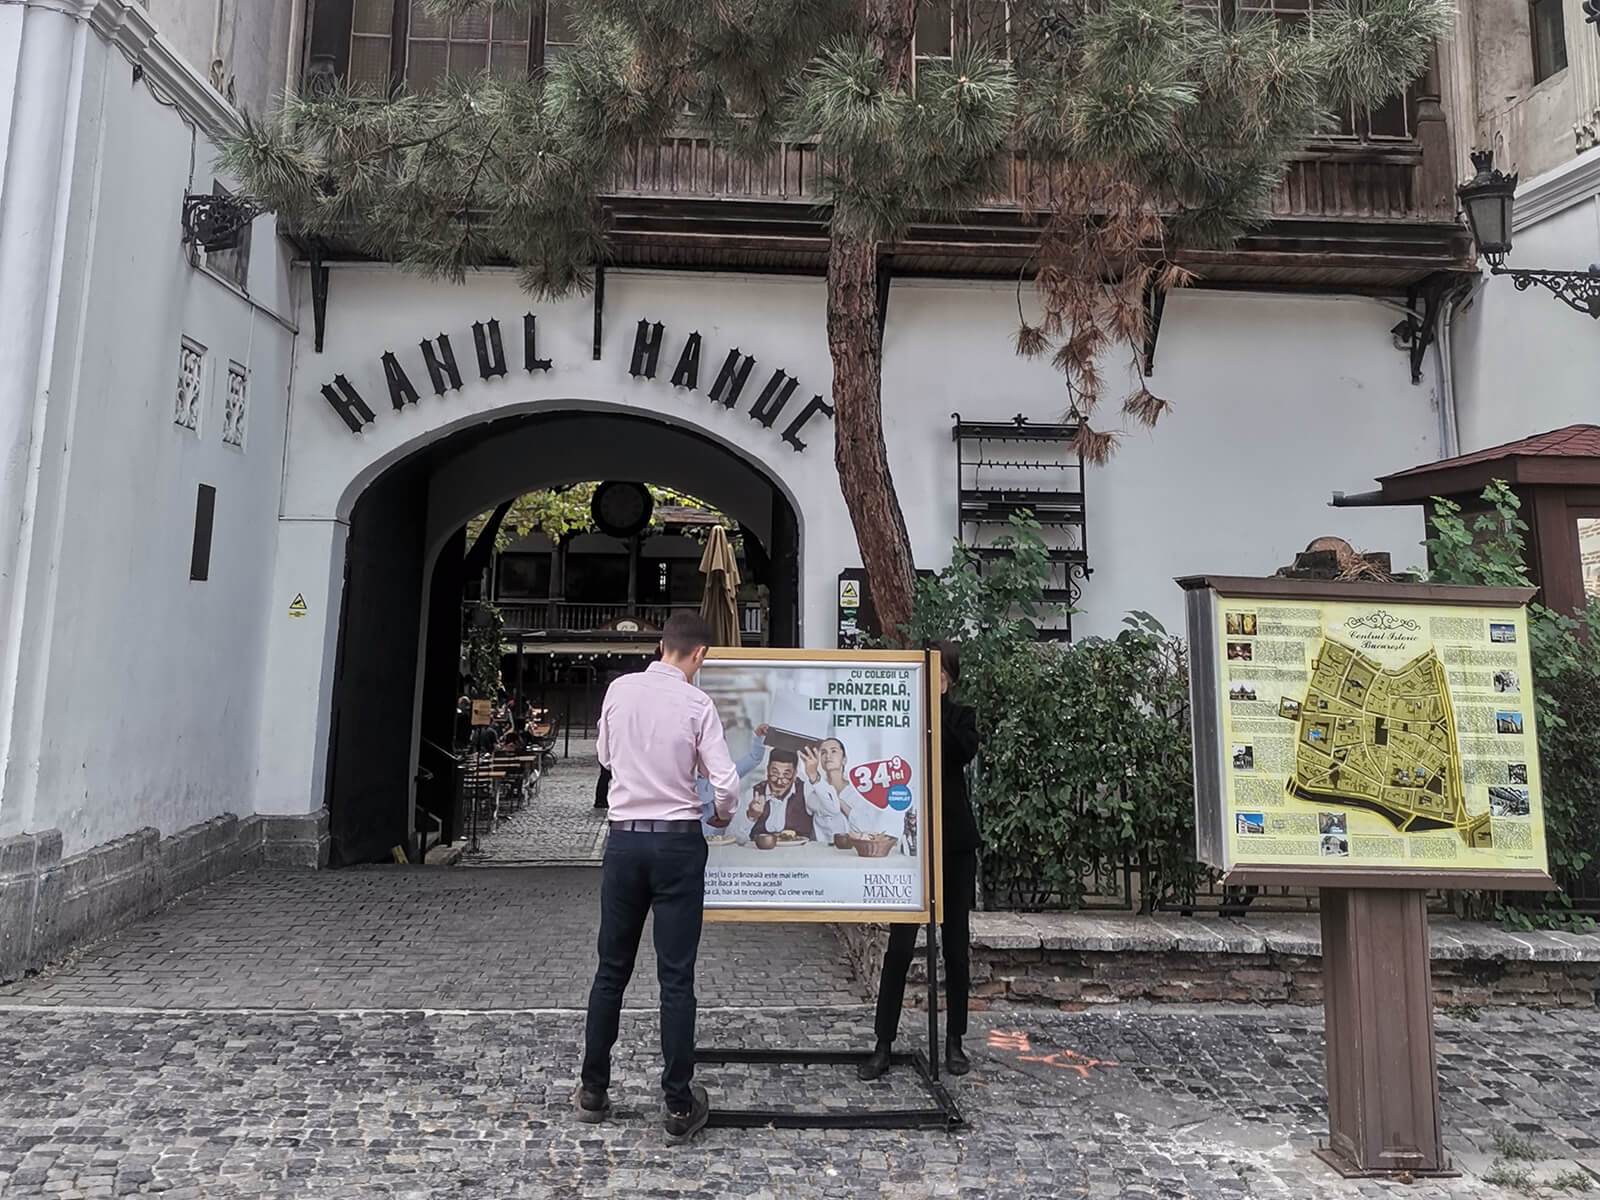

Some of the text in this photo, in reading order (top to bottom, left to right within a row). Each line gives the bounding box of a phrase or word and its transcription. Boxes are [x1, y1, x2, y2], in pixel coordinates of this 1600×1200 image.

[320, 311, 553, 434] HANUL
[851, 670, 910, 679] CU COLEGII LA
[809, 698, 910, 712] IEFTIN, DAR NU
[833, 712, 910, 728] IEFTINEALĂ
[864, 885, 912, 898] MANUC
